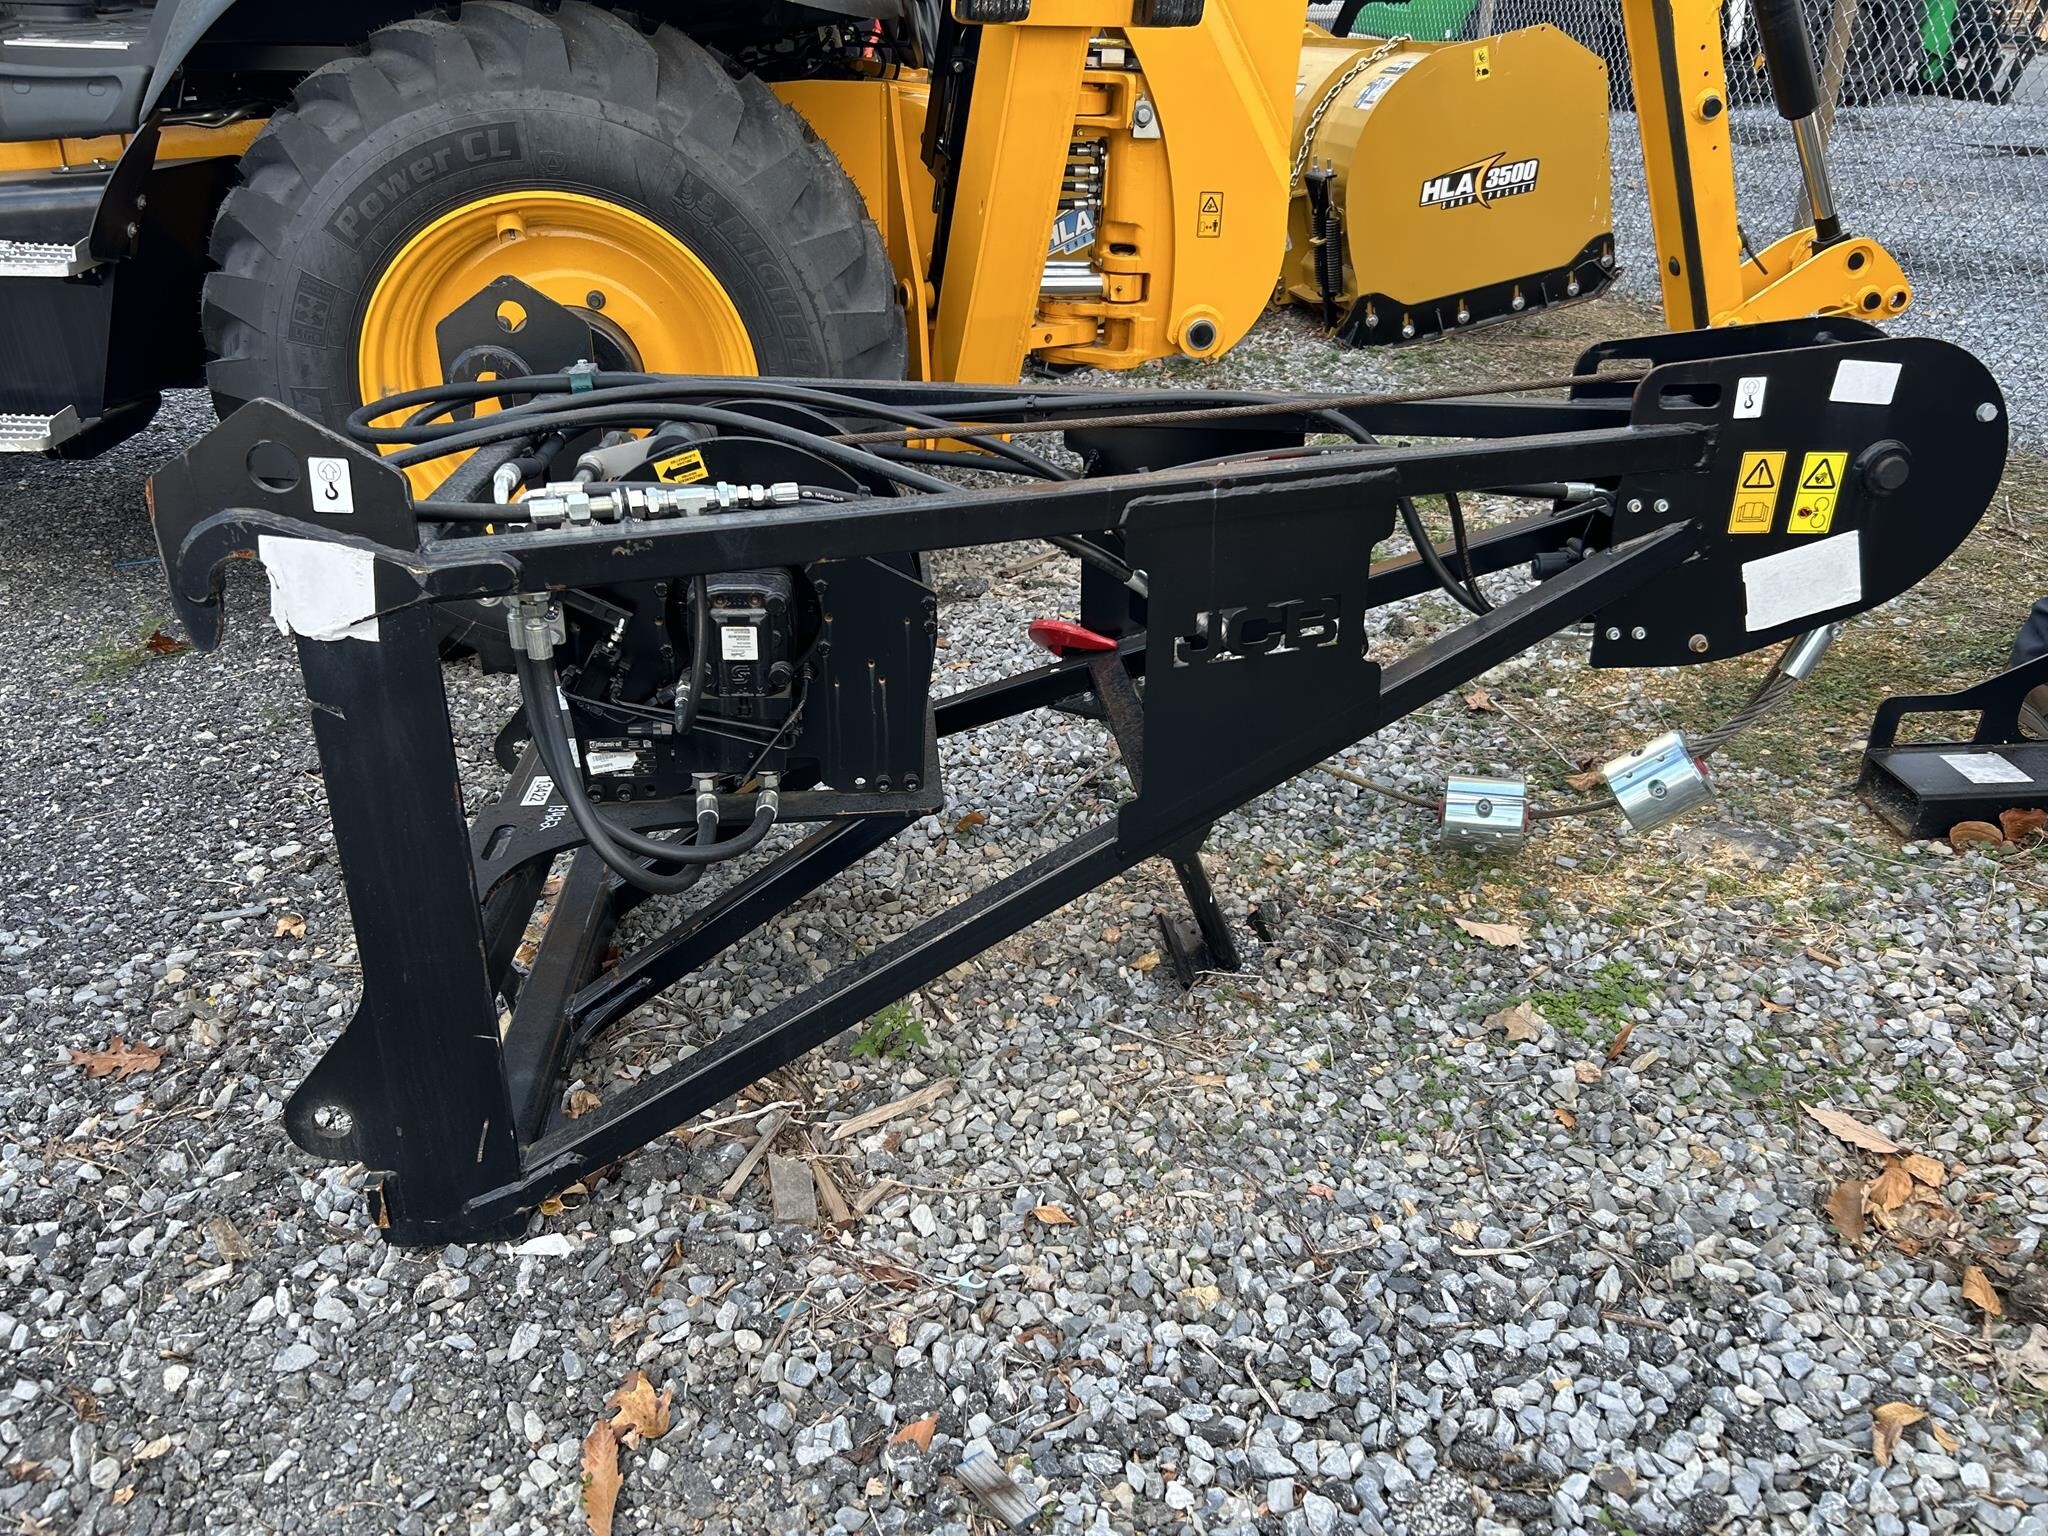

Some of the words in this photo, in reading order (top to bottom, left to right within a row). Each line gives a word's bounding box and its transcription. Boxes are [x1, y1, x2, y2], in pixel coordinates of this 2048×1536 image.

[334, 147, 452, 242] Power
[461, 129, 512, 163] CL
[1421, 172, 1474, 203] HLA
[1485, 159, 1539, 189] 3500
[1173, 594, 1341, 668] JCB
[528, 779, 553, 802] 13422
